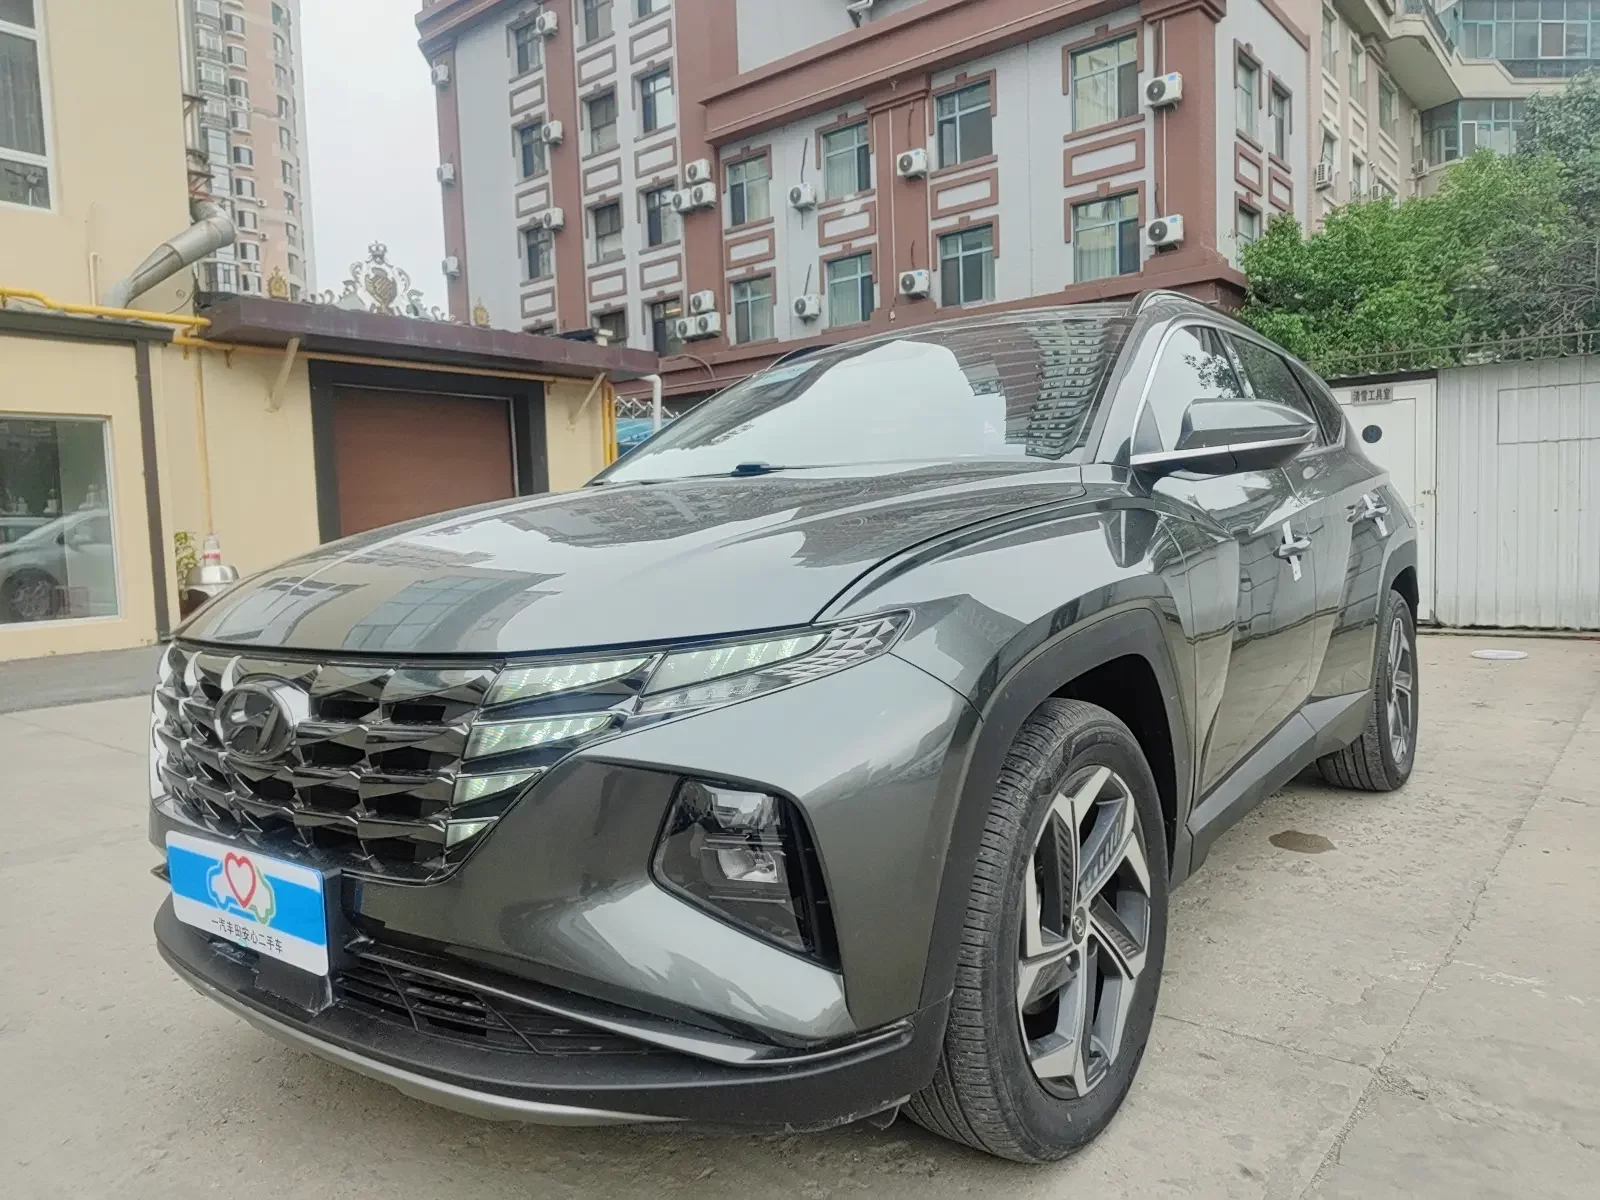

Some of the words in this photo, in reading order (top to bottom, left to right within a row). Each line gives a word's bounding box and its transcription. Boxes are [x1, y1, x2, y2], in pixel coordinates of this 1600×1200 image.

[211, 917, 283, 954] 一汽丰田安心二手车
